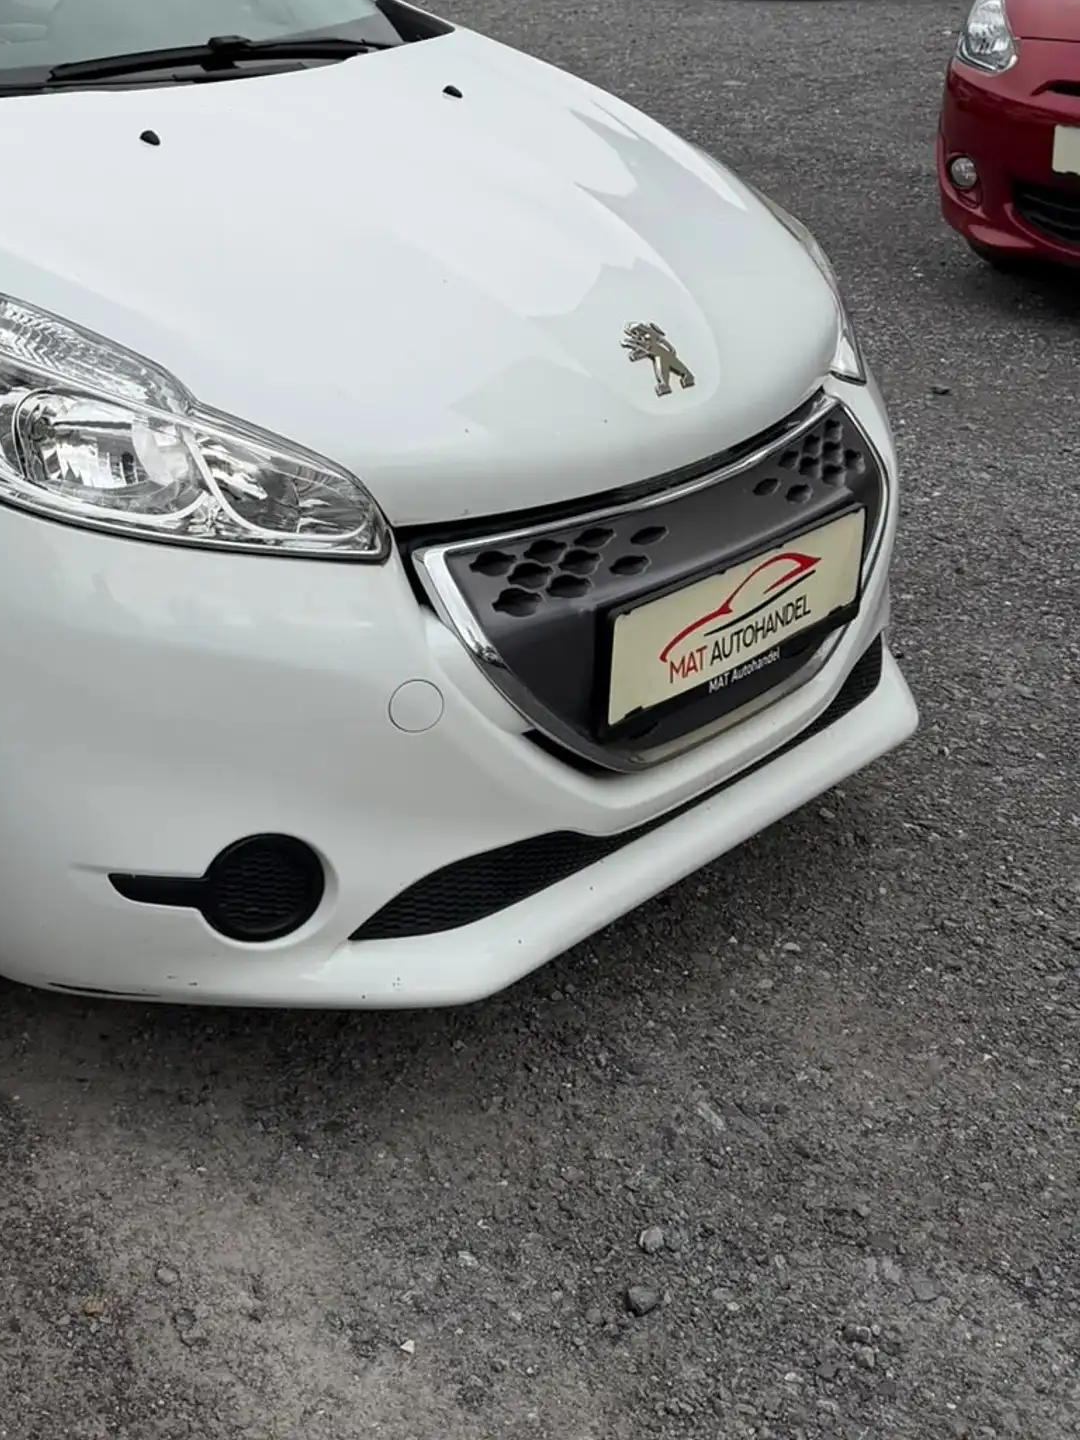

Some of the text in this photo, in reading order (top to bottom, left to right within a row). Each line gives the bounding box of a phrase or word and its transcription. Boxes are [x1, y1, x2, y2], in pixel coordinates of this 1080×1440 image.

[669, 594, 812, 684] MAT AUTOHANDEL
[708, 645, 781, 694] MAT Autohandel
